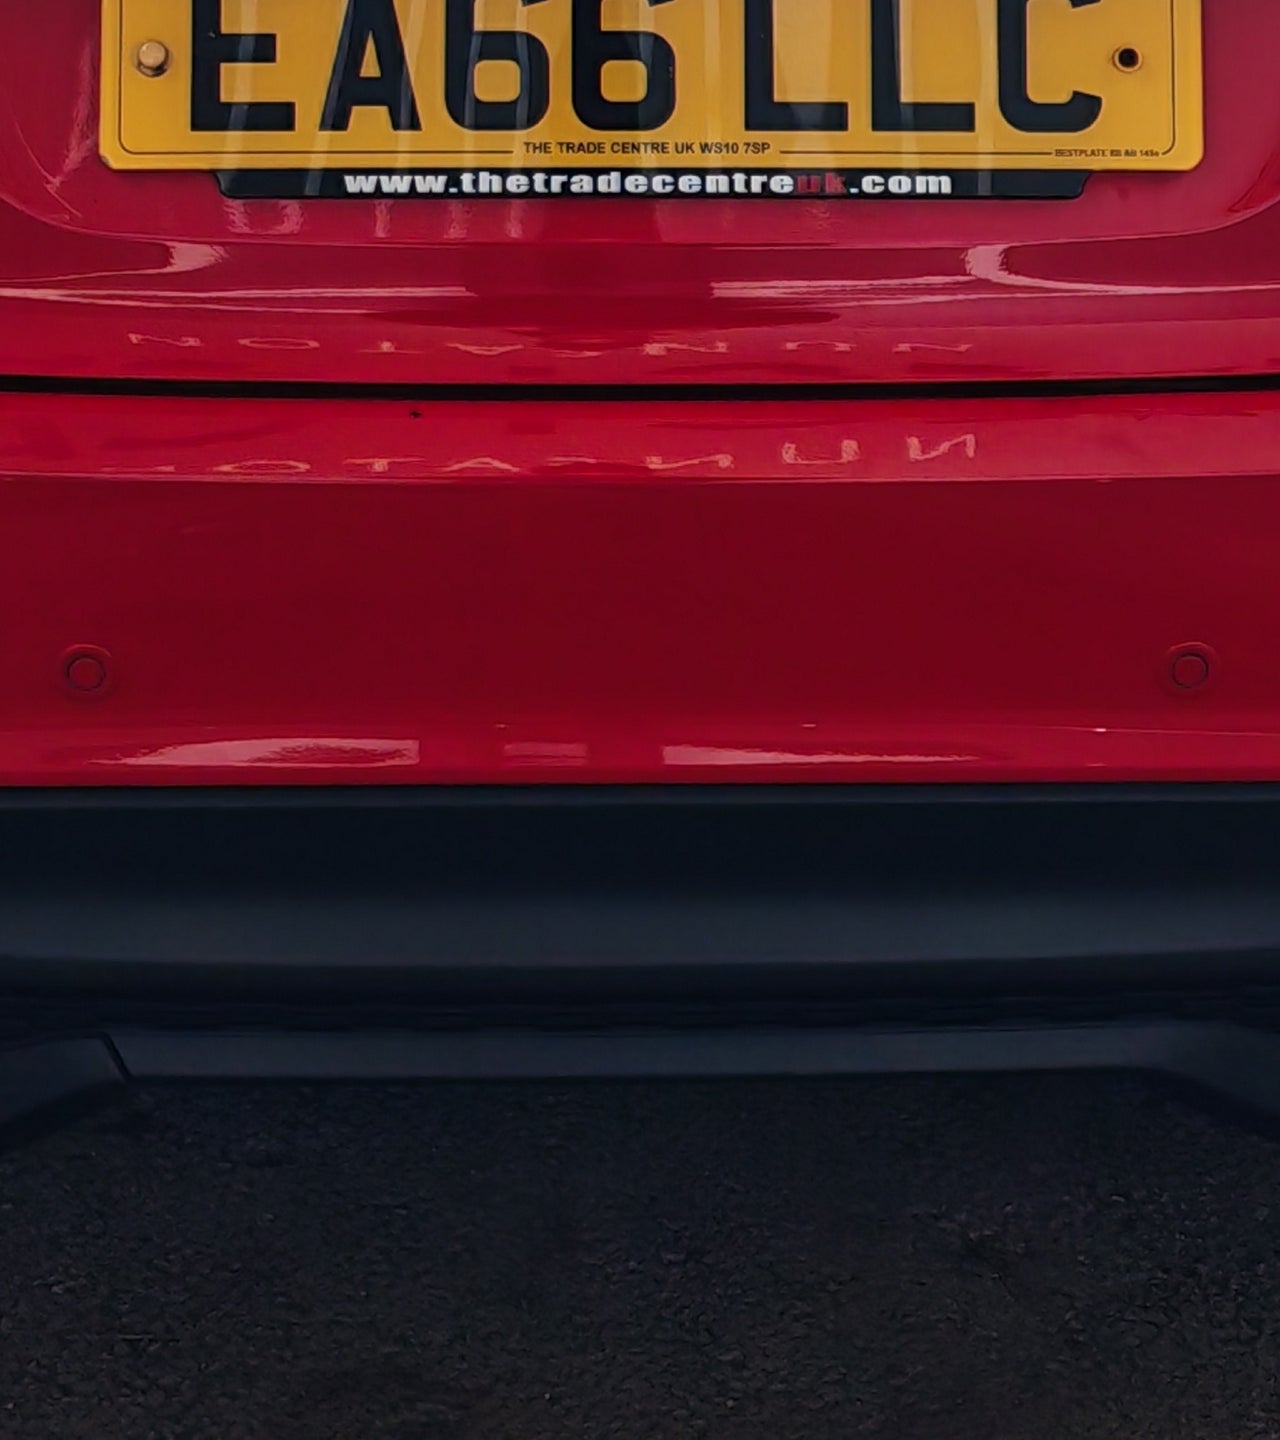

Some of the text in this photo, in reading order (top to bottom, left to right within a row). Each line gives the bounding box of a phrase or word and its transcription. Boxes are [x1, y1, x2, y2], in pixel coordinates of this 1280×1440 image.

[524, 141, 771, 155] THE TRADE CENTRE UK WS10 7SP
[343, 171, 953, 195] www.thetradecentreuk.com
